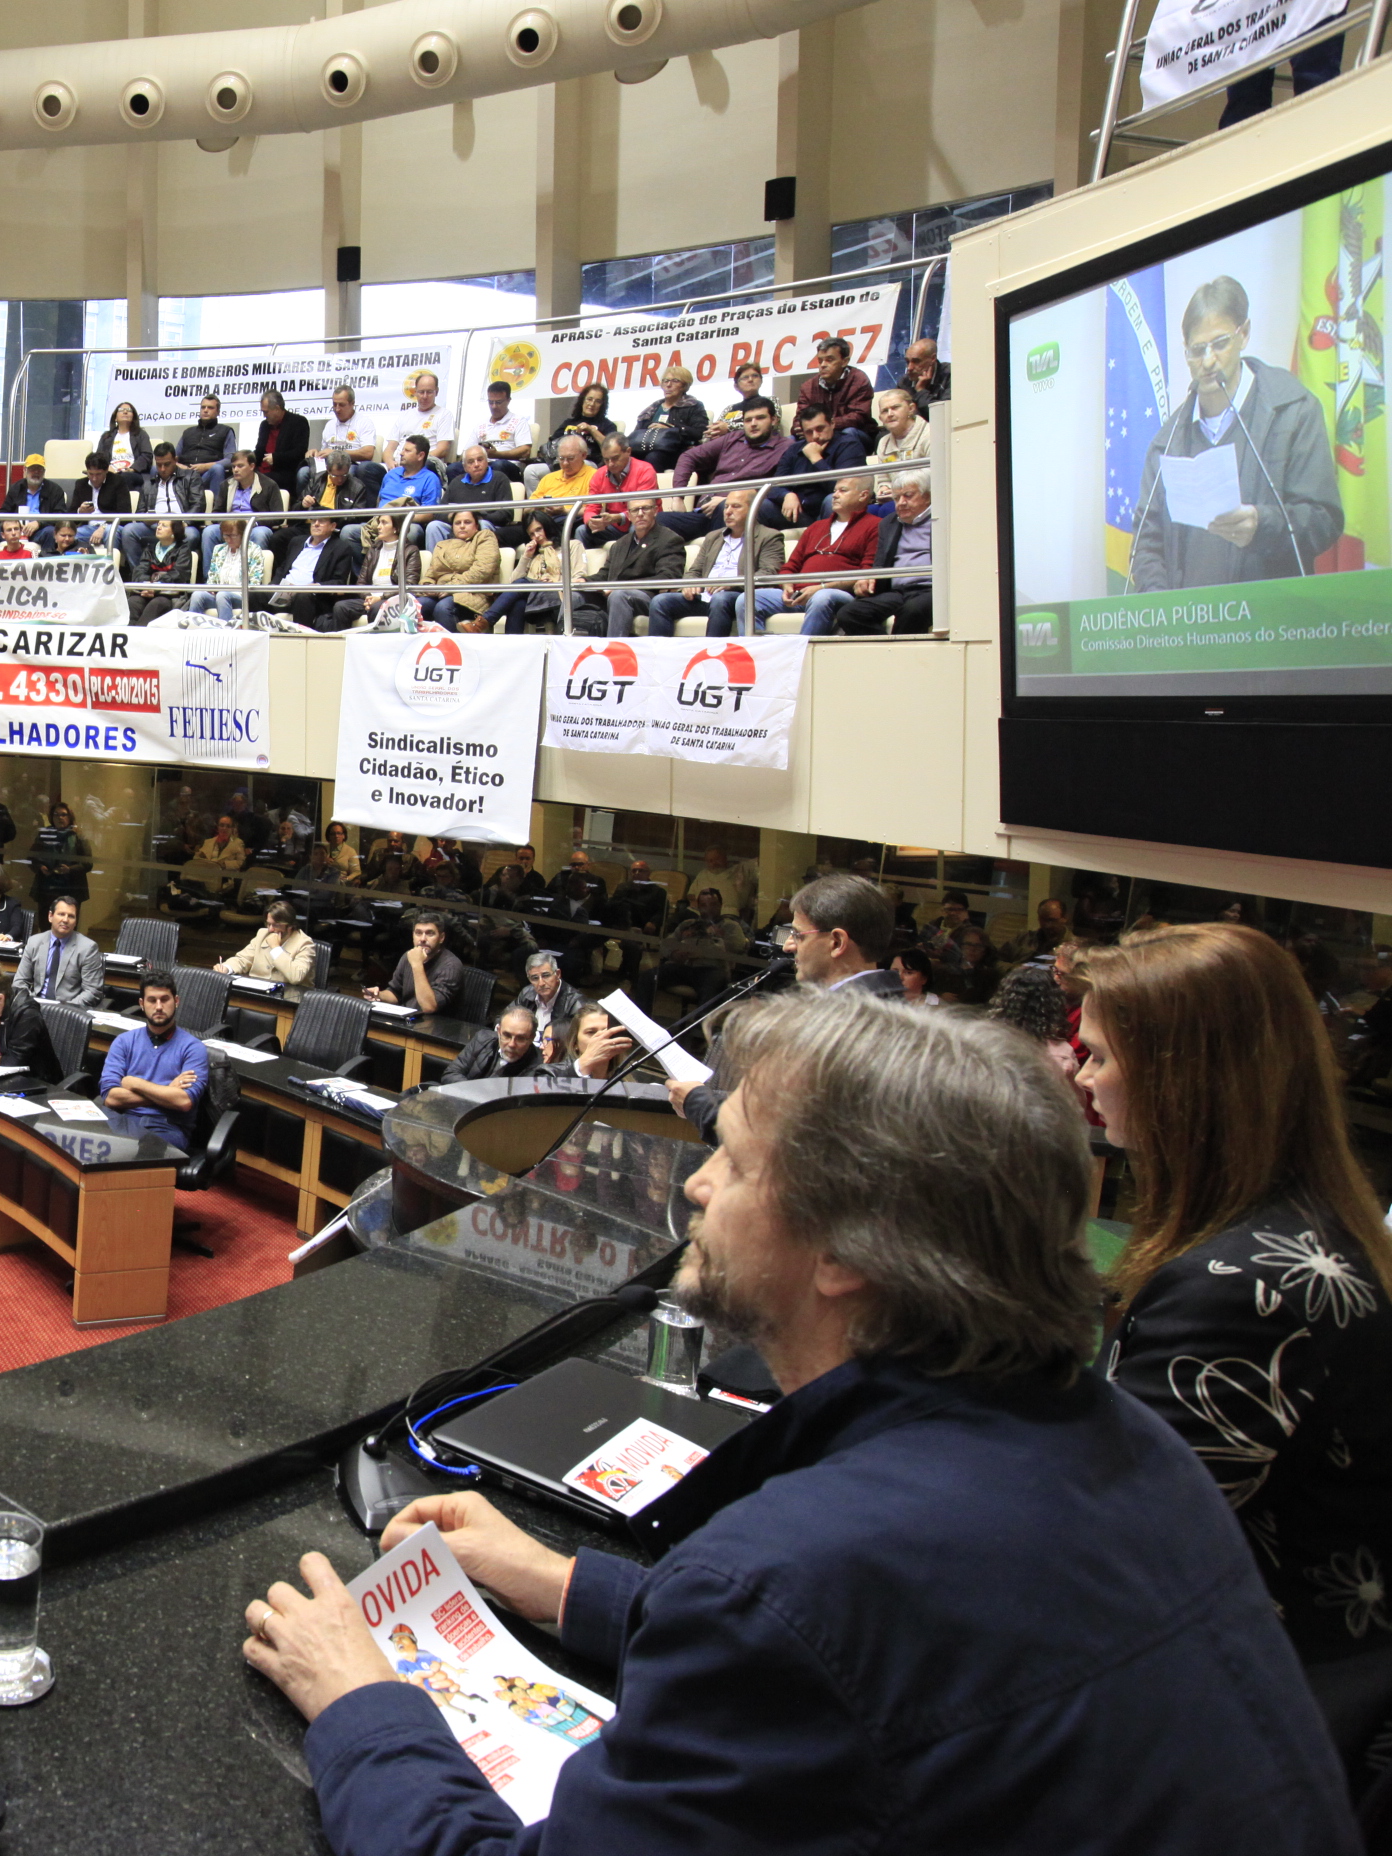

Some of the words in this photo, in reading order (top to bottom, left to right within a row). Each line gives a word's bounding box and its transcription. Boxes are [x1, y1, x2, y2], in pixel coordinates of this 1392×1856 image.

[1184, 33, 1215, 54] GERAL
[1218, 19, 1241, 40] DOS
[1187, 61, 1199, 74] DE
[1201, 45, 1235, 66] SANTA
[551, 329, 602, 344] APRASC
[613, 317, 695, 337] Associação
[699, 314, 717, 325] de
[721, 307, 773, 325] Praças
[777, 301, 797, 314] do
[800, 294, 855, 312] Estado
[859, 290, 879, 305] de
[632, 333, 672, 348] Santa
[676, 326, 740, 344] Catarina
[115, 368, 169, 380] POLICIAIS
[173, 368, 178, 378] E
[181, 364, 249, 378] BOMBEIROS
[252, 360, 314, 375] MILITARES
[317, 360, 332, 372] DE
[335, 357, 375, 371] SANTA
[378, 352, 441, 369] CATARINA
[729, 336, 798, 379] PLC
[165, 385, 208, 397] CONTRA
[213, 383, 219, 395] A
[224, 382, 277, 395] REFORMA
[281, 380, 295, 392] DA
[299, 375, 379, 391] PREVIDÊNCIA
[1080, 608, 1166, 632] AUDIÊNCIA
[1173, 601, 1251, 627] PÚBLICA
[1081, 637, 1134, 651] Comissão
[1137, 633, 1184, 648] Direitos
[1187, 630, 1251, 646] Humanos
[1255, 627, 1274, 642] do
[1279, 622, 1337, 640] Senado
[1342, 619, 1392, 637] Feder
[10, 670, 84, 704] 4330
[90, 674, 158, 707] PLC-30/2015
[414, 666, 461, 685] UGT
[566, 677, 636, 705] UGT
[677, 681, 751, 713] UGT
[168, 705, 260, 743] FETIESC
[563, 715, 579, 725] GERAL
[581, 717, 593, 726] DOS
[595, 717, 646, 729] TRABALHADORE
[563, 729, 569, 737] DE
[571, 729, 589, 738] SANTA
[590, 731, 619, 740] CATARINA
[651, 718, 670, 729] UNIÃO
[673, 721, 693, 733] GERAL
[695, 724, 709, 735] DOS
[712, 726, 768, 738] TRABALHADORES
[367, 731, 498, 758] Sindicalismo
[671, 736, 680, 745] DE
[681, 738, 704, 748] SANTA
[706, 740, 735, 751] CATARINA
[359, 757, 444, 785] Cidadão,
[451, 759, 505, 787] Ético
[371, 789, 383, 803] e
[388, 786, 484, 813] Inovador!
[616, 1430, 675, 1474] MOVIDA
[361, 1548, 441, 1627] OVIDA
[433, 1607, 446, 1620] SC
[460, 1603, 470, 1614] de
